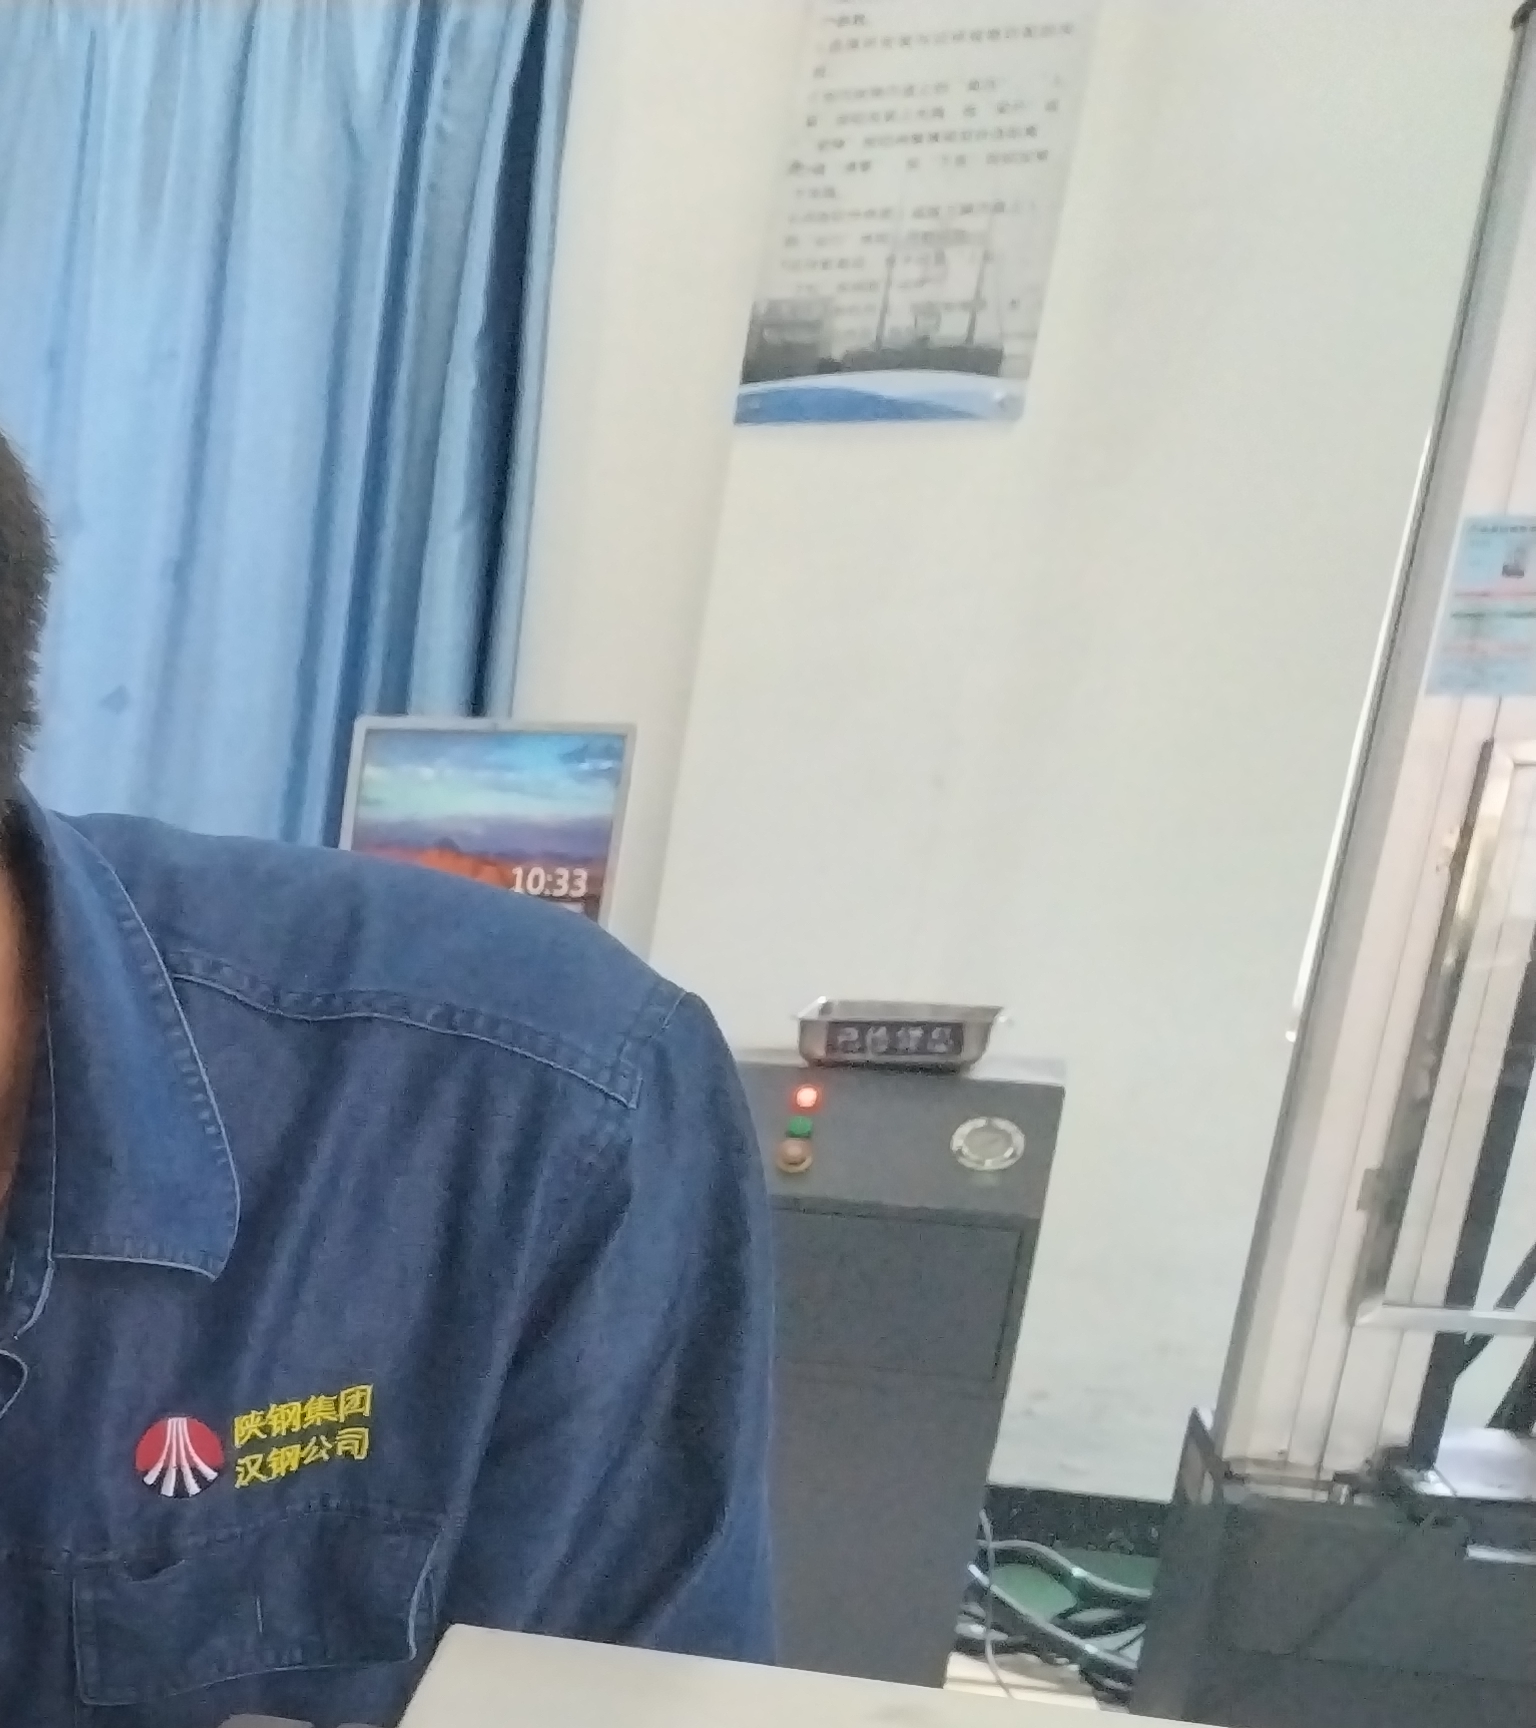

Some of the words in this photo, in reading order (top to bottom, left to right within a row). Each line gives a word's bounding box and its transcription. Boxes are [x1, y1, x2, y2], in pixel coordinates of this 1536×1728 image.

[511, 866, 587, 897] 10:33
[234, 1384, 373, 1449] 陕钢集团
[234, 1426, 369, 1489] 汉钢公司
